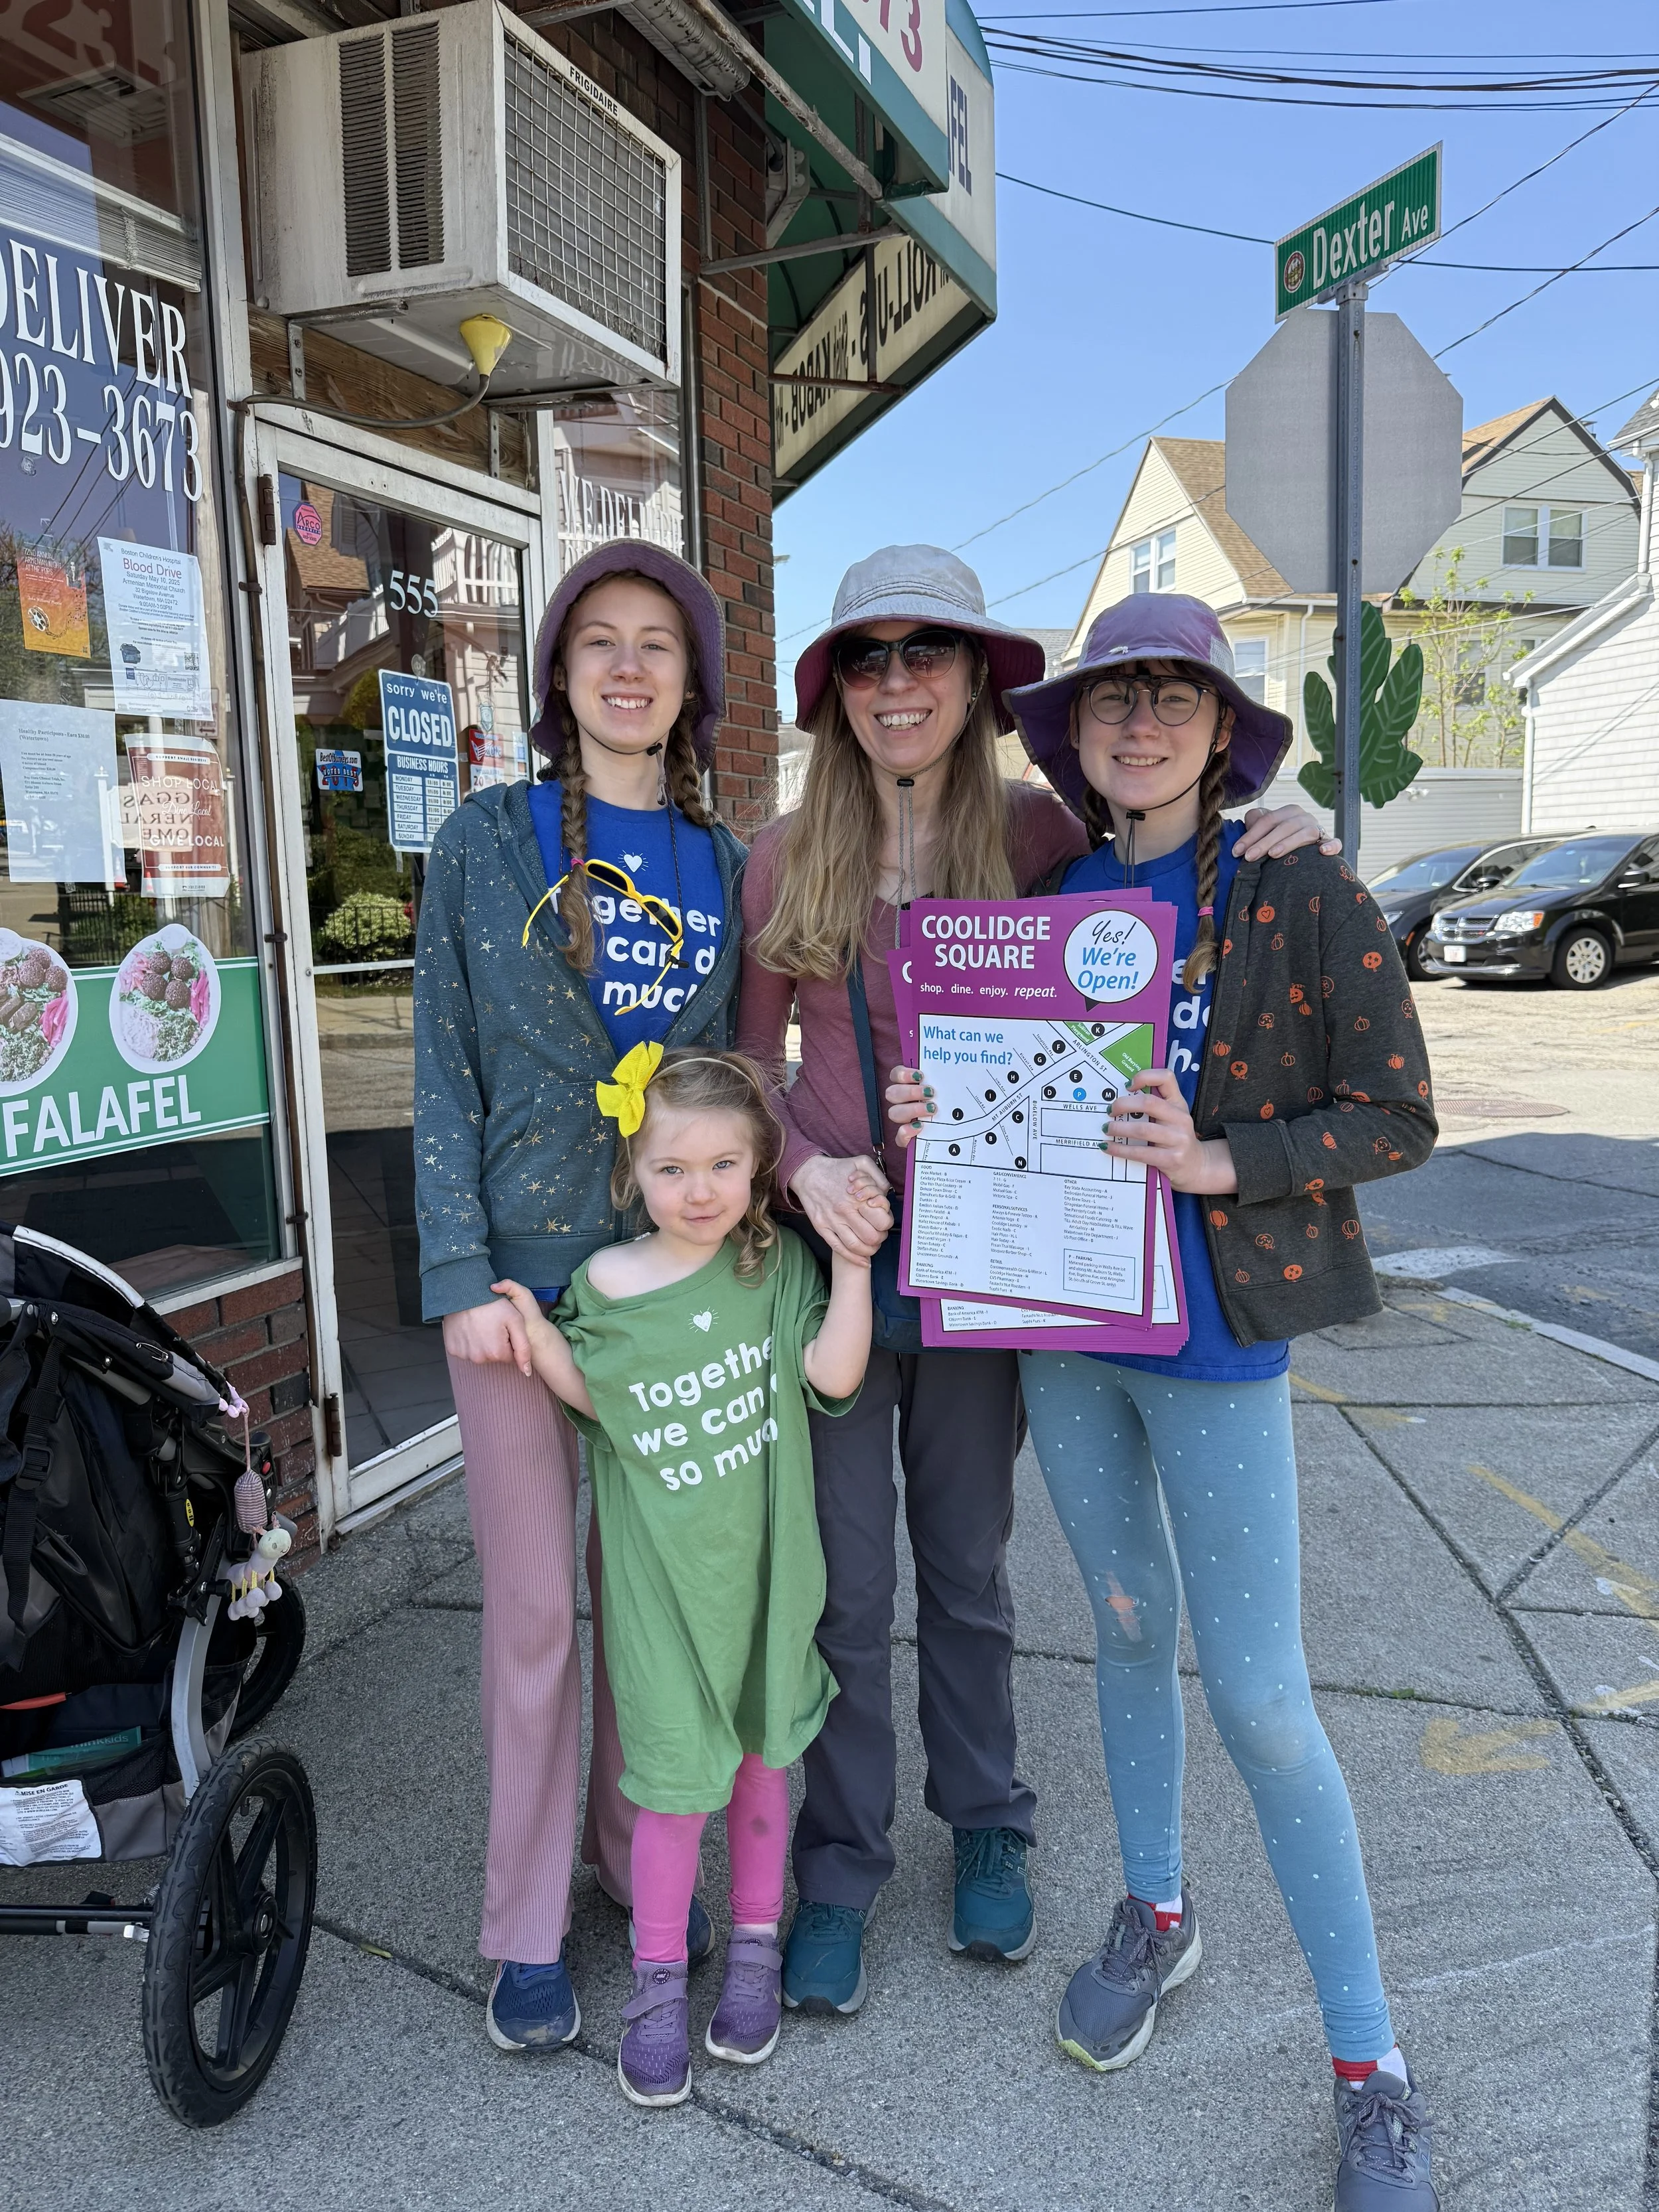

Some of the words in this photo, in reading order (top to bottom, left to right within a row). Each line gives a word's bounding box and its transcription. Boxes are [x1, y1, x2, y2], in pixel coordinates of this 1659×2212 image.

[569, 66, 618, 116] FRIGIDAIRE
[948, 75, 972, 196] FEL
[1313, 200, 1394, 290] Dexter
[1402, 204, 1428, 242] Ave
[297, 512, 321, 530] ARCO
[121, 548, 138, 557] Boston
[139, 552, 162, 561] Children's
[163, 556, 181, 565] Hospital
[123, 557, 153, 574] Blood
[157, 564, 182, 579] Drive
[126, 571, 148, 581] Saturday
[149, 575, 159, 583] May
[123, 578, 145, 587] Armenian
[146, 582, 168, 591] Memorial
[390, 569, 439, 618] 555
[386, 683, 416, 700] sorry
[421, 688, 447, 704] we're
[388, 706, 453, 748] CLOSED
[397, 755, 427, 771] BUSINESS
[428, 759, 449, 774] HOURS
[141, 775, 182, 788] SHOP
[186, 778, 218, 790] LOCAL
[161, 800, 187, 816] Dine
[191, 801, 212, 818] Local
[149, 835, 184, 846] GIVE
[188, 836, 224, 847] LOCAL
[922, 915, 1051, 940] COOLIDGE
[1092, 920, 1137, 945] Yes!
[934, 944, 1035, 971] SQUARE
[1082, 947, 1137, 967] We're
[920, 982, 944, 995] shop.
[951, 984, 974, 995] dine.
[979, 985, 1008, 999] enjoy.
[1014, 986, 1058, 1000] repeat.
[1077, 970, 1139, 994] Open!
[924, 1026, 956, 1041] What
[960, 1031, 981, 1042] can
[985, 1033, 1003, 1043] we
[1070, 1025, 1090, 1043] Playground
[924, 1046, 951, 1064] help
[954, 1052, 977, 1065] you
[980, 1050, 1013, 1065] find?
[1072, 1039, 1100, 1067] ARLINGTON
[1100, 1064, 1108, 1072] ST
[1121, 1052, 1130, 1061] Old
[1128, 1057, 1141, 1071] Burying
[1121, 1059, 1135, 1073] Ground
[2, 1074, 201, 1157] FALAFEL
[999, 1098, 1018, 1117] AUBURN
[628, 1331, 774, 1412] Togethe
[632, 1422, 689, 1456] we
[701, 1386, 764, 1435] can
[660, 1461, 703, 1491] so
[46, 1784, 68, 1793] GARDE
